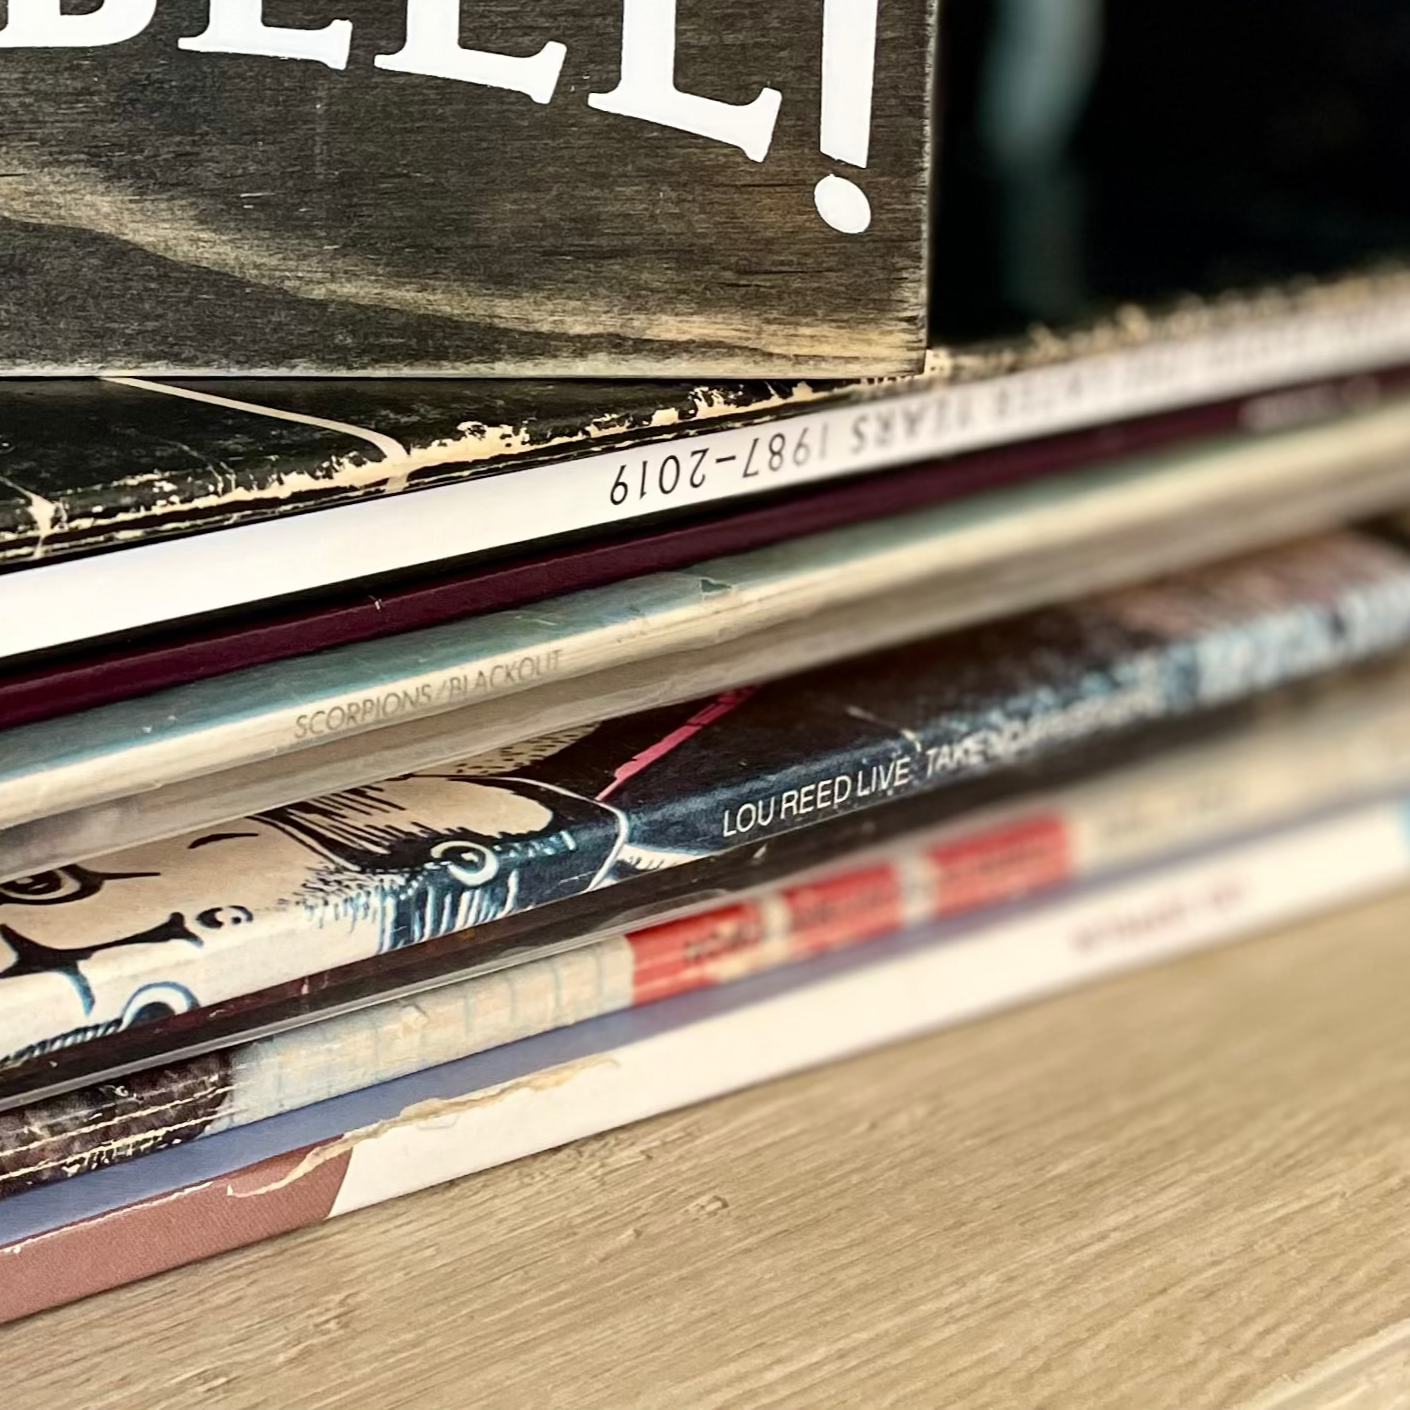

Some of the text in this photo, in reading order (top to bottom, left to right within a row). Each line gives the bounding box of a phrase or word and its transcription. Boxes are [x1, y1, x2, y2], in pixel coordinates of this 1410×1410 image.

[722, 800, 775, 838] LOU
[780, 774, 852, 821] REED
[856, 756, 912, 798] LIVE
[925, 736, 986, 779] TAKE
